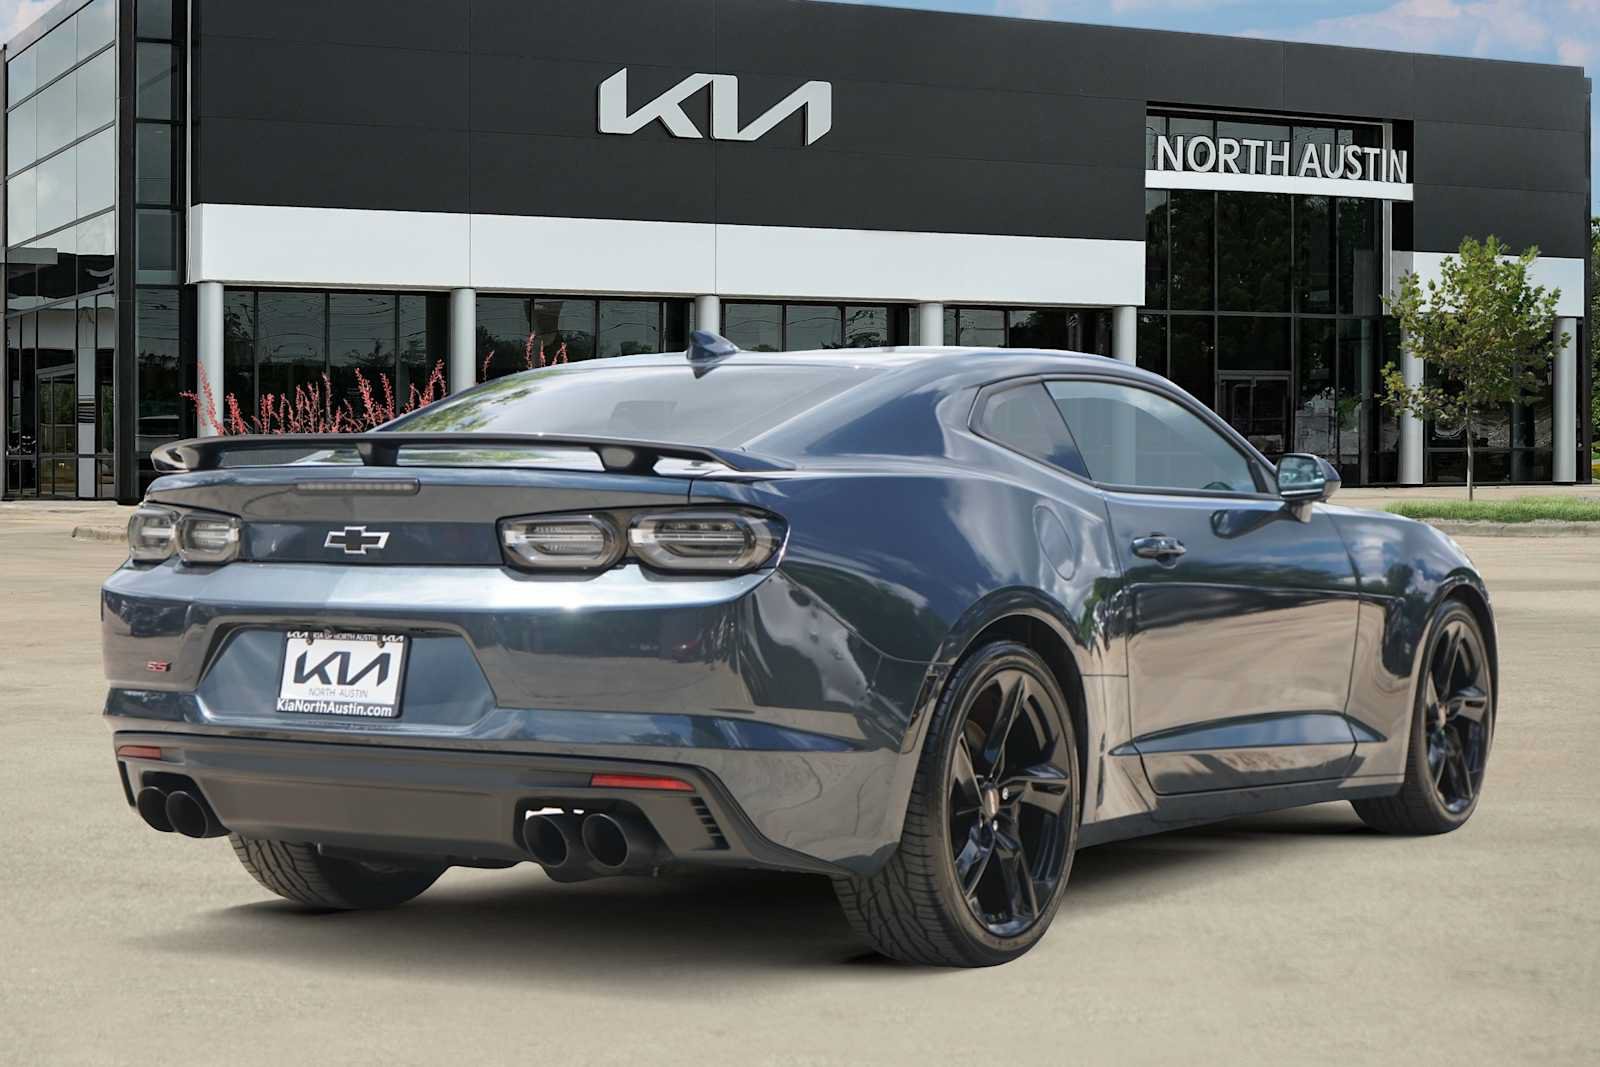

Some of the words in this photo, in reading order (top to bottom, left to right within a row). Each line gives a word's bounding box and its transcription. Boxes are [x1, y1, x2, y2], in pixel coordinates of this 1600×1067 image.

[598, 67, 832, 146] KIA
[1156, 134, 1290, 177] NORTH
[1299, 143, 1408, 184] AUSTIN
[356, 633, 378, 641] AUSTIN
[293, 650, 391, 687] KIA
[276, 698, 393, 717] KiaNorthAustin.com
[309, 688, 336, 697] NORTH
[339, 689, 369, 699] AUSTIN
